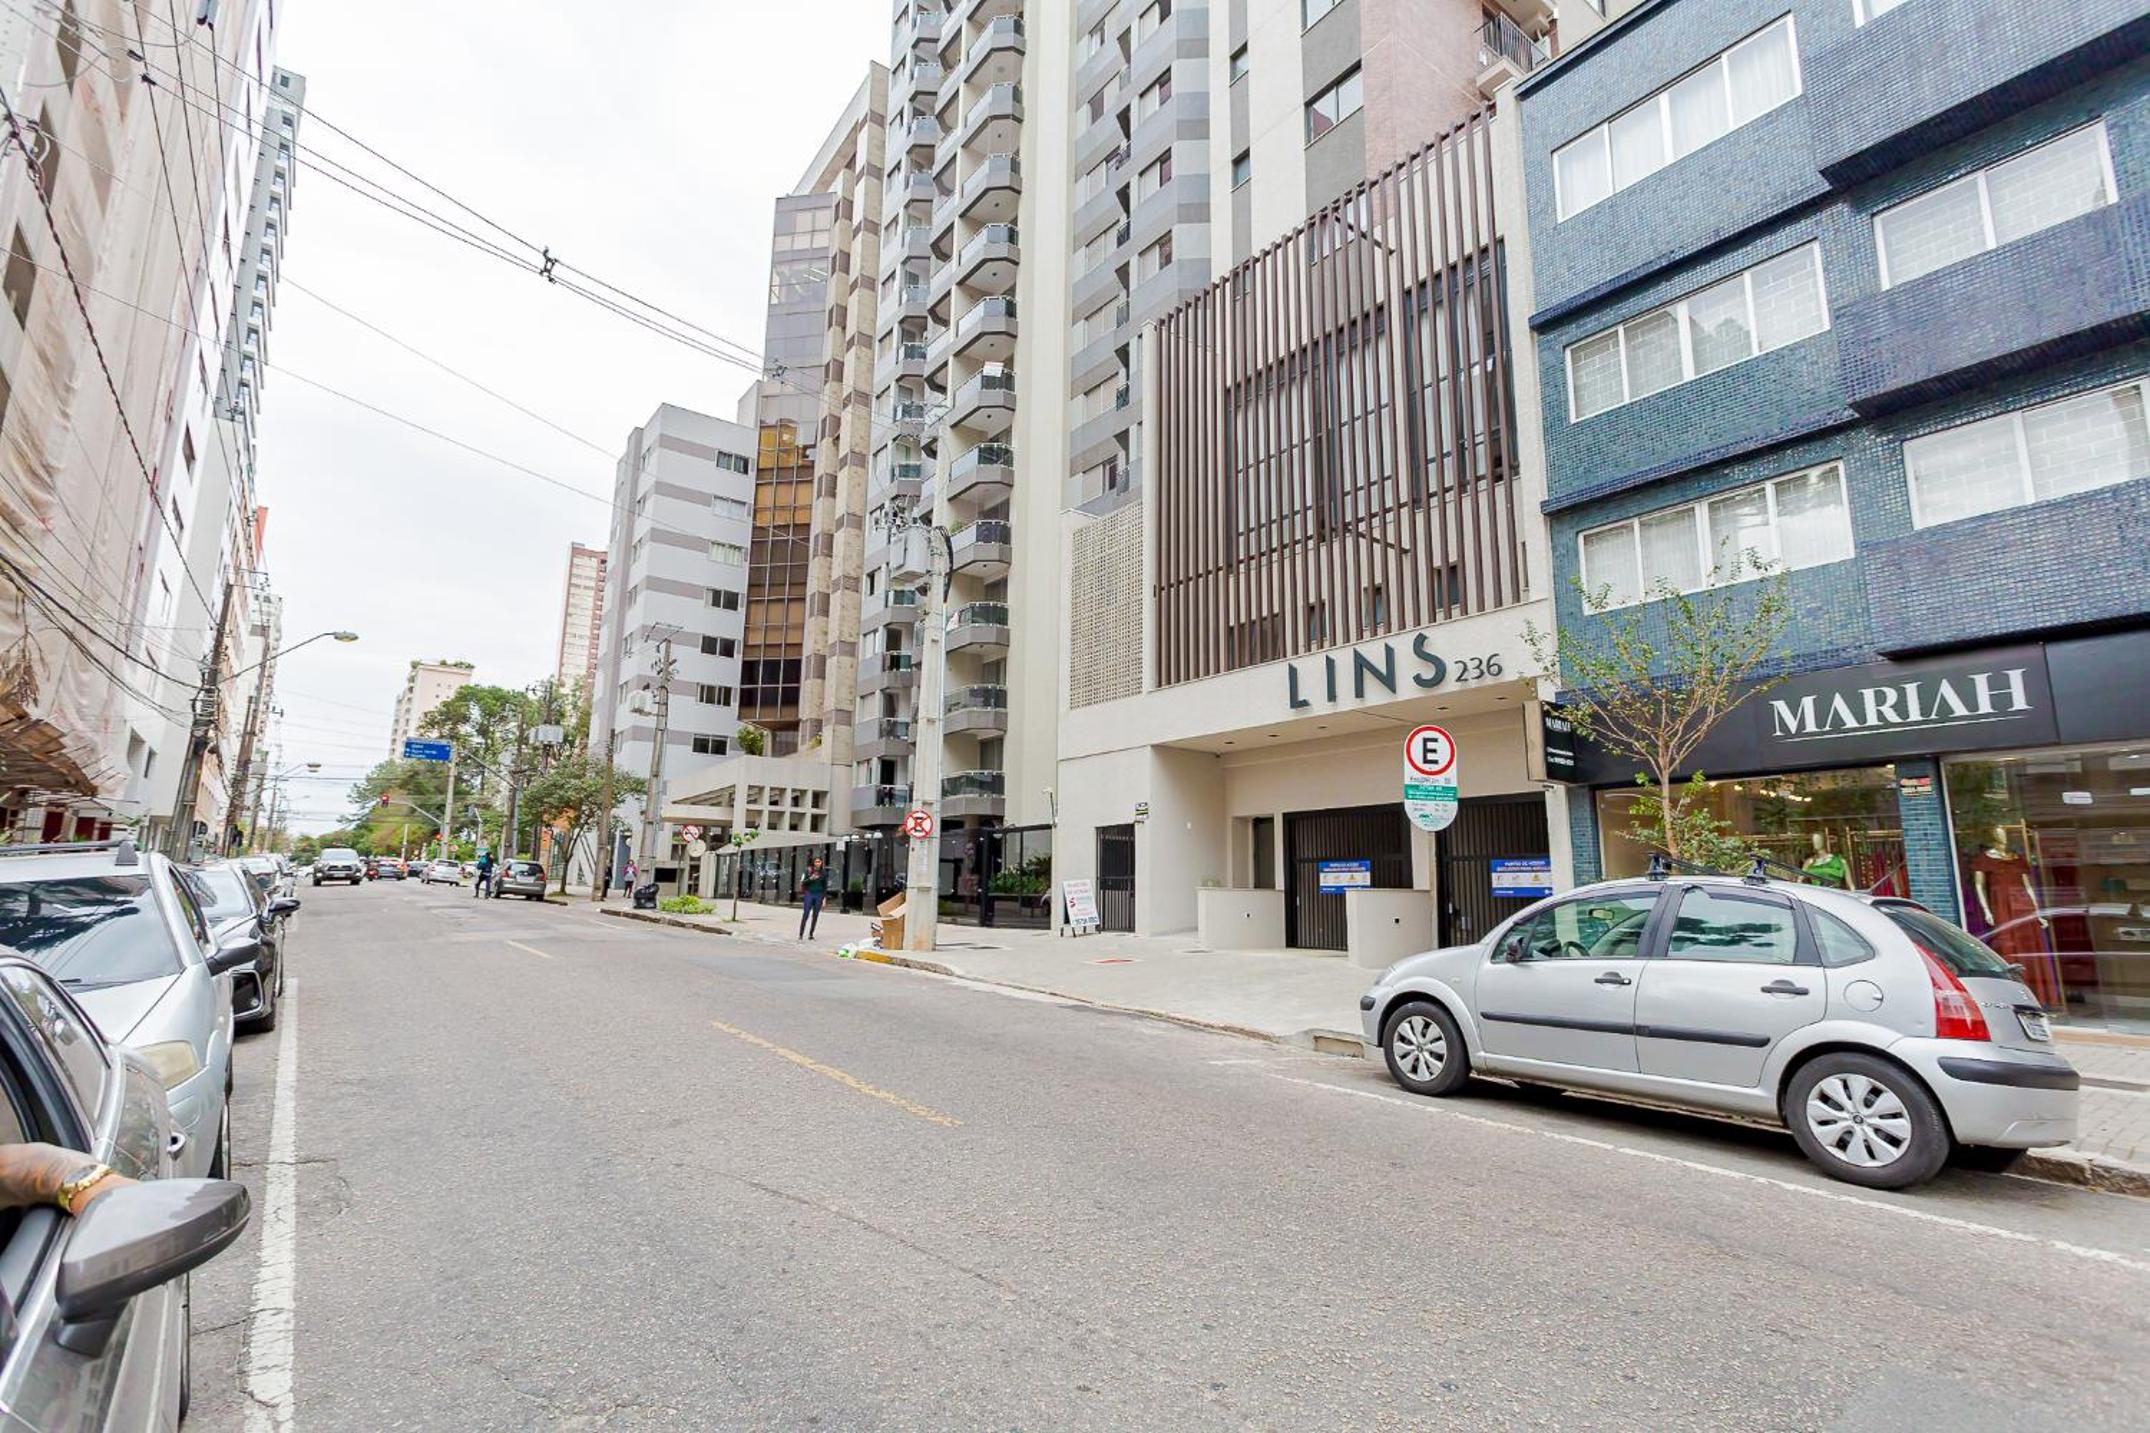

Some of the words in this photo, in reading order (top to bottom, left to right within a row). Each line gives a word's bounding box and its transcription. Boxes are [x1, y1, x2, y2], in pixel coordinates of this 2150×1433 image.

[1288, 632, 1447, 709] LINS
[1454, 653, 1503, 682] 236
[1769, 668, 2034, 736] MARIAH
[1422, 737, 1440, 765] E
